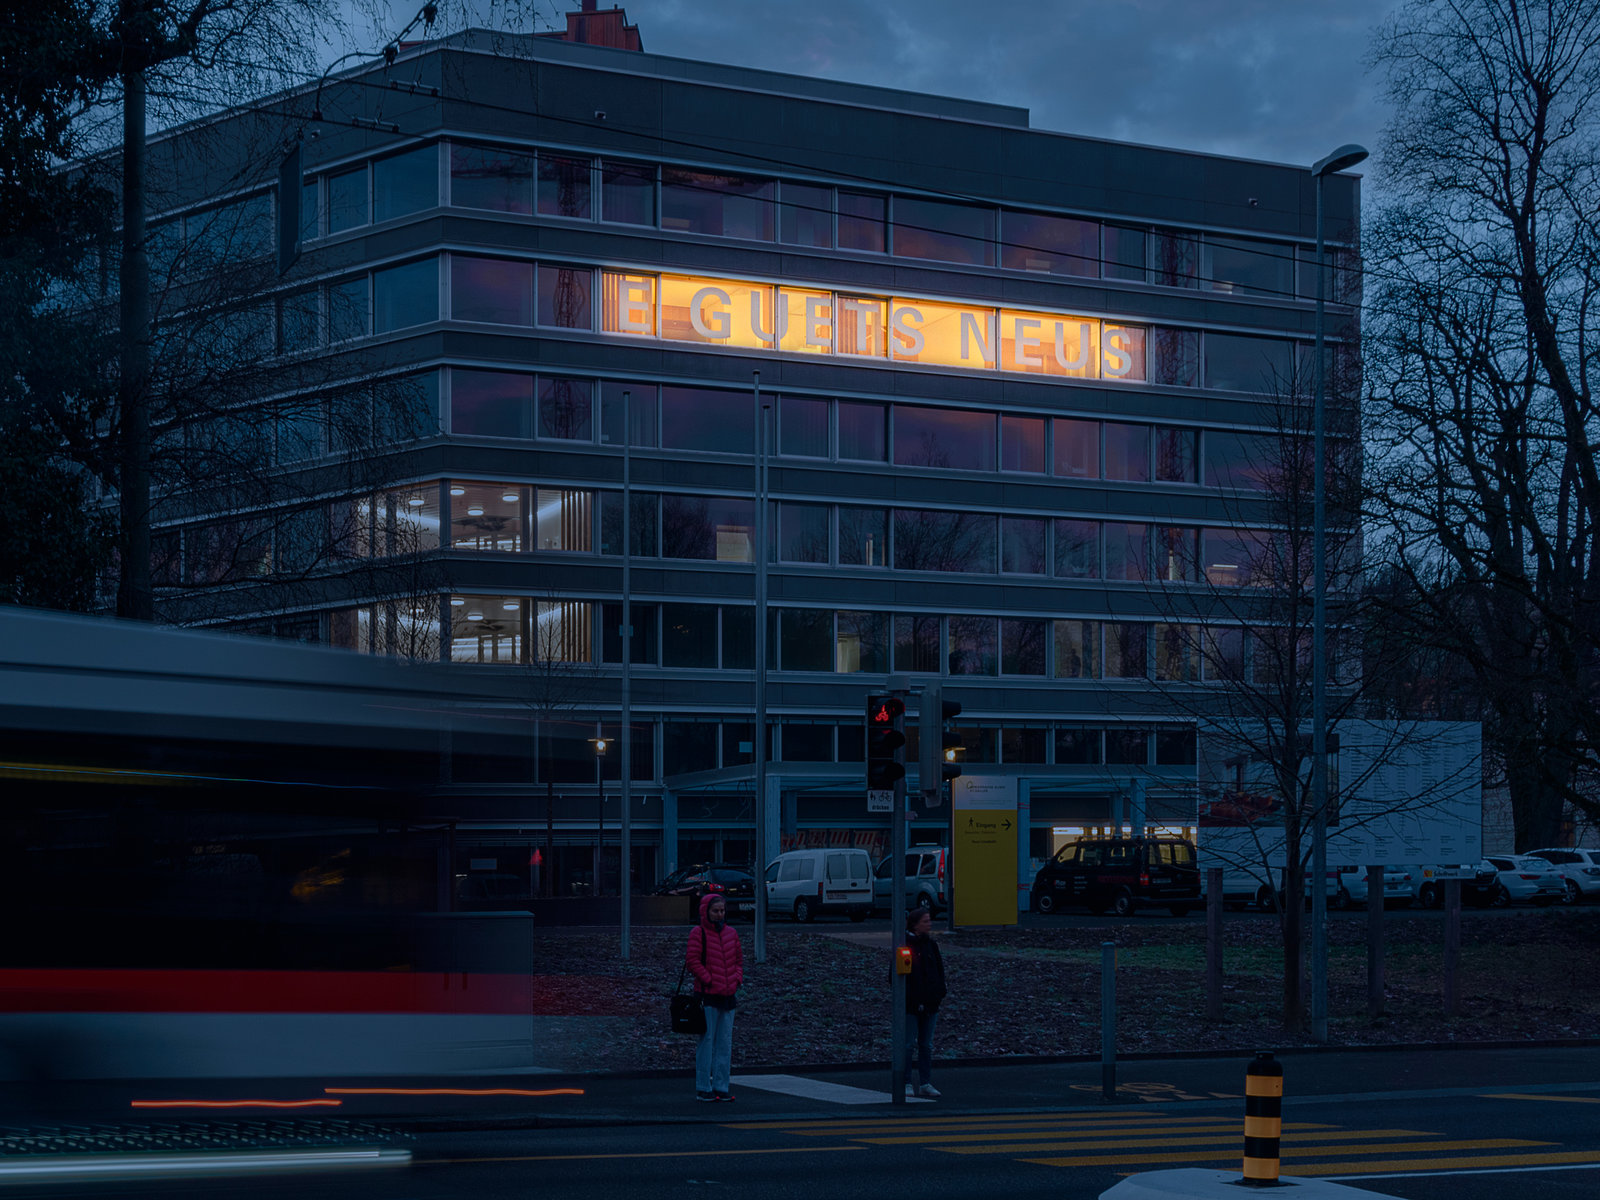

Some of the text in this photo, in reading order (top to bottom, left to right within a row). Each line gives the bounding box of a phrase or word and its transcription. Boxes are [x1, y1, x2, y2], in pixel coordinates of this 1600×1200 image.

[617, 279, 1133, 376] E GUETS NEUS
